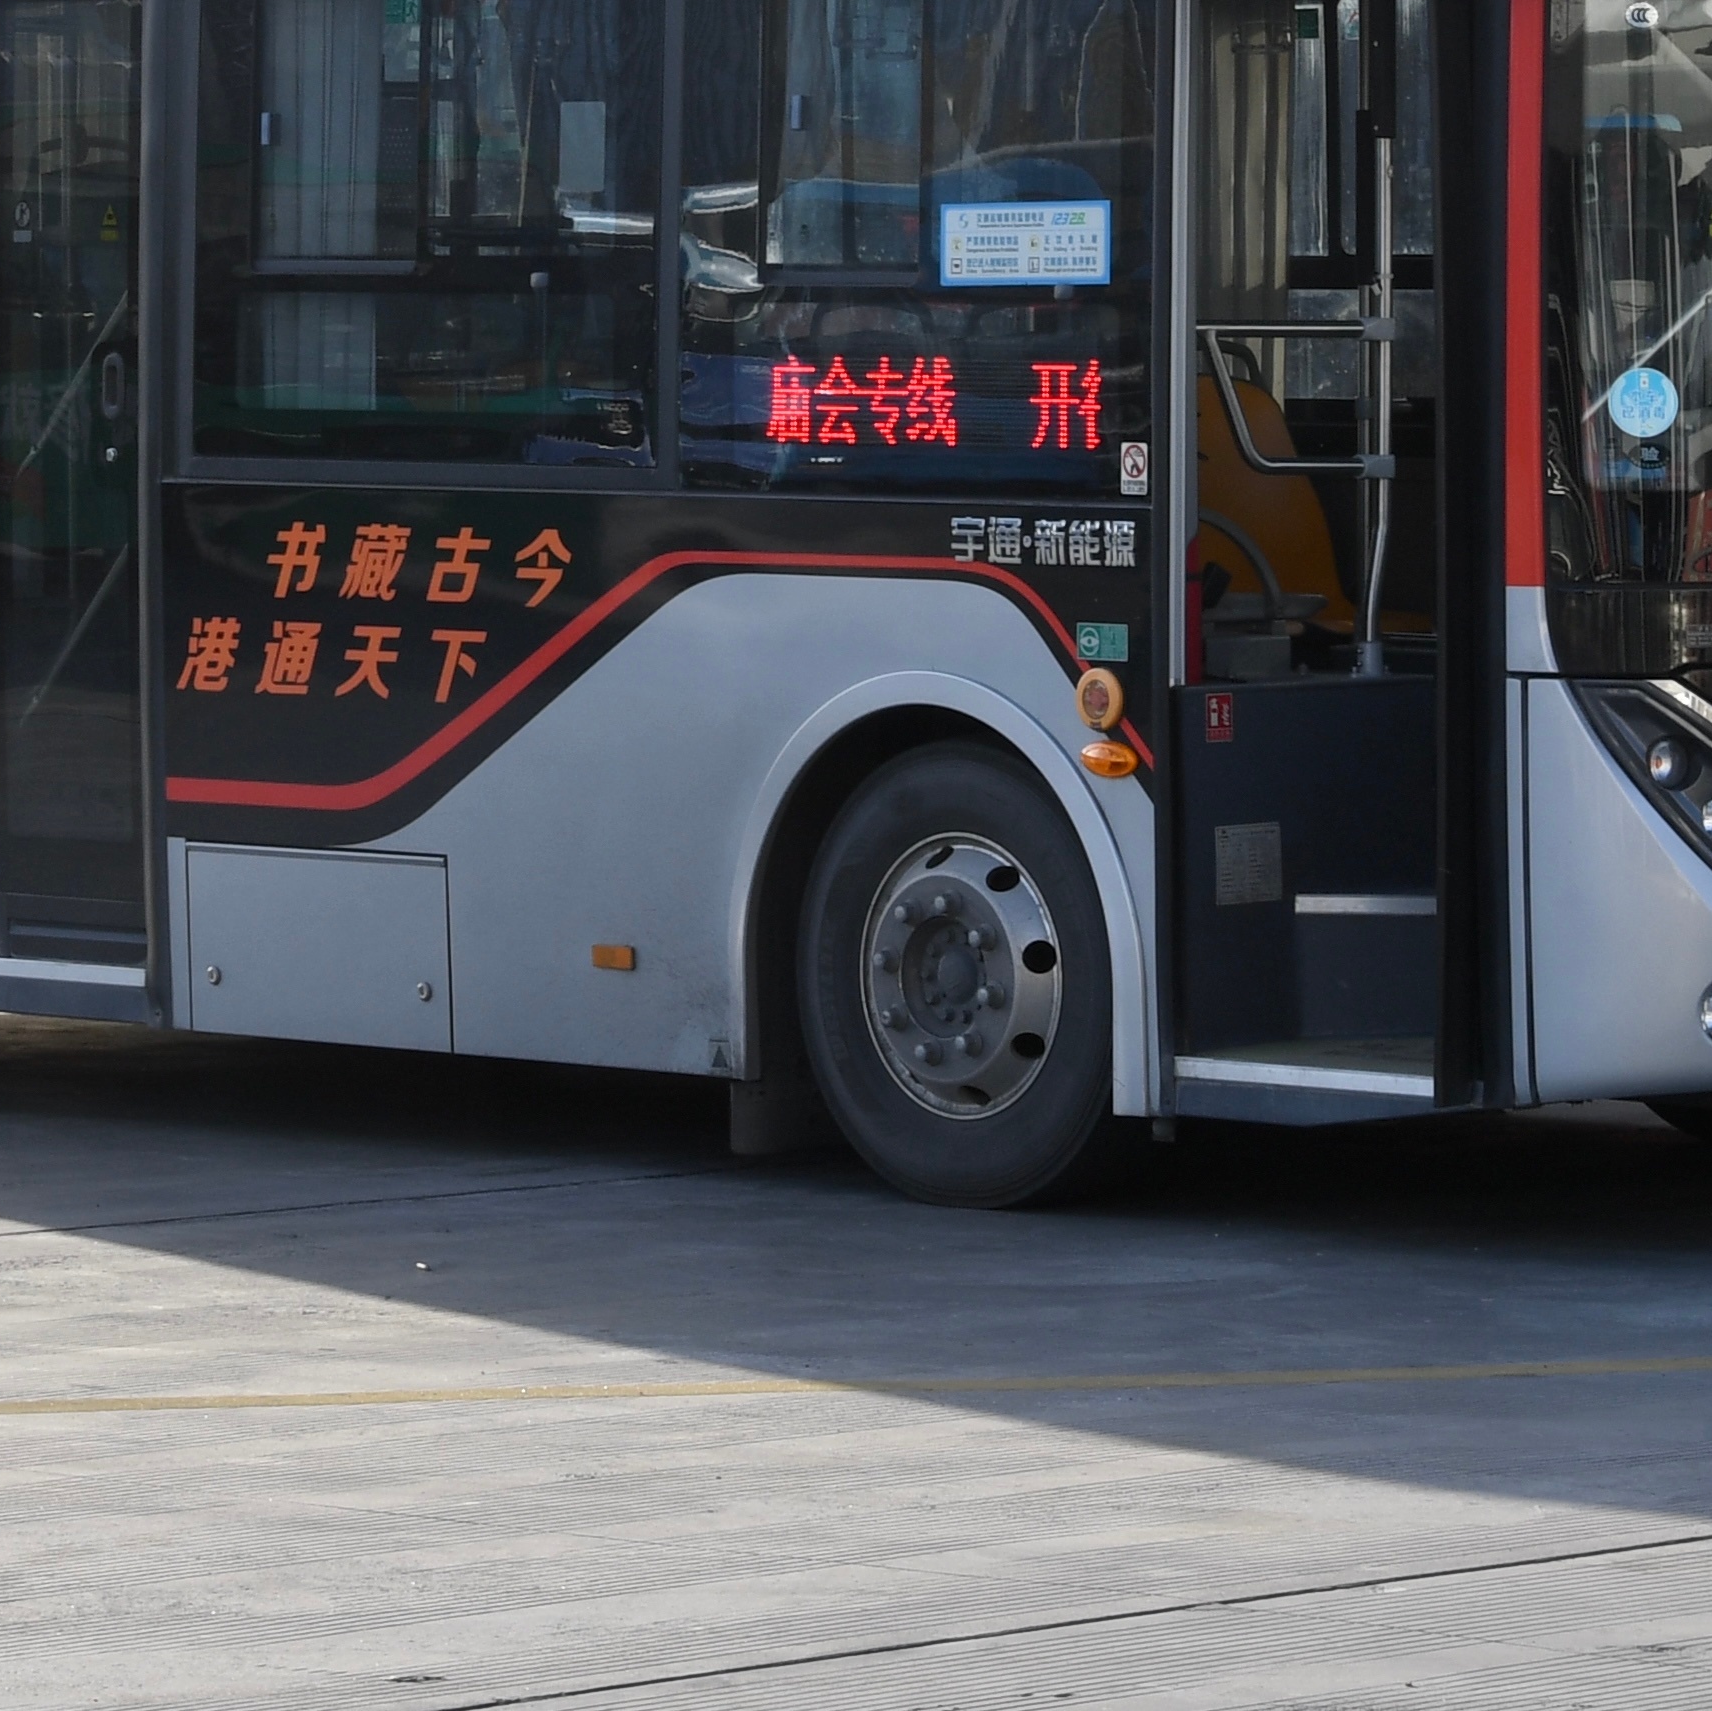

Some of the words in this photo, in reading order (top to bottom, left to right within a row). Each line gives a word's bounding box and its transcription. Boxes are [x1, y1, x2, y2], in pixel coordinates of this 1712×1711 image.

[766, 354, 958, 447] 庙会专线
[1621, 406, 1666, 420] 已消毒
[266, 520, 572, 608] 书藏古今
[950, 516, 1136, 568] 宇通·新能源
[177, 616, 488, 704] 港通天下
